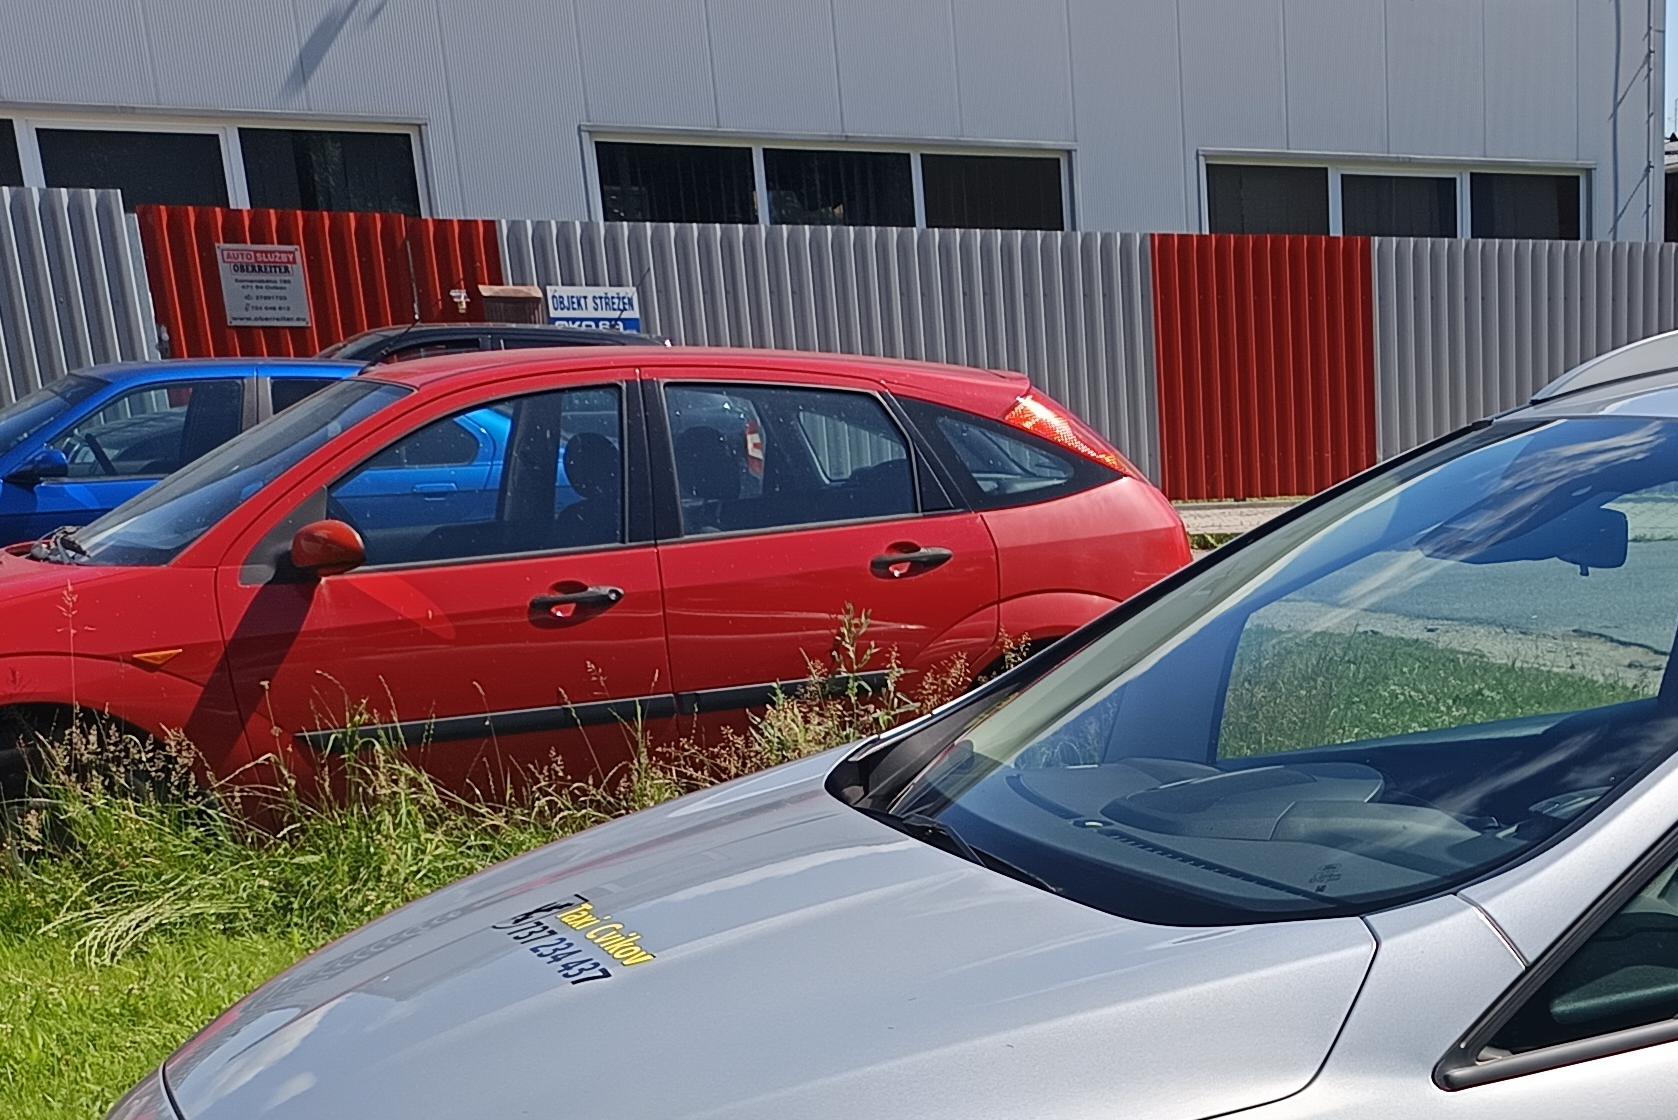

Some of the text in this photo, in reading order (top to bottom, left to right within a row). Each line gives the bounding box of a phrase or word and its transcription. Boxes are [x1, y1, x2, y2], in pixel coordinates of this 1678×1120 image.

[226, 252, 253, 261] AUTO
[232, 264, 290, 274] OBERREITER
[551, 291, 635, 312] OBJEKT STŘEŽEN
[556, 902, 654, 967] Taxi Cvikov
[507, 920, 612, 985] 737 234 437
